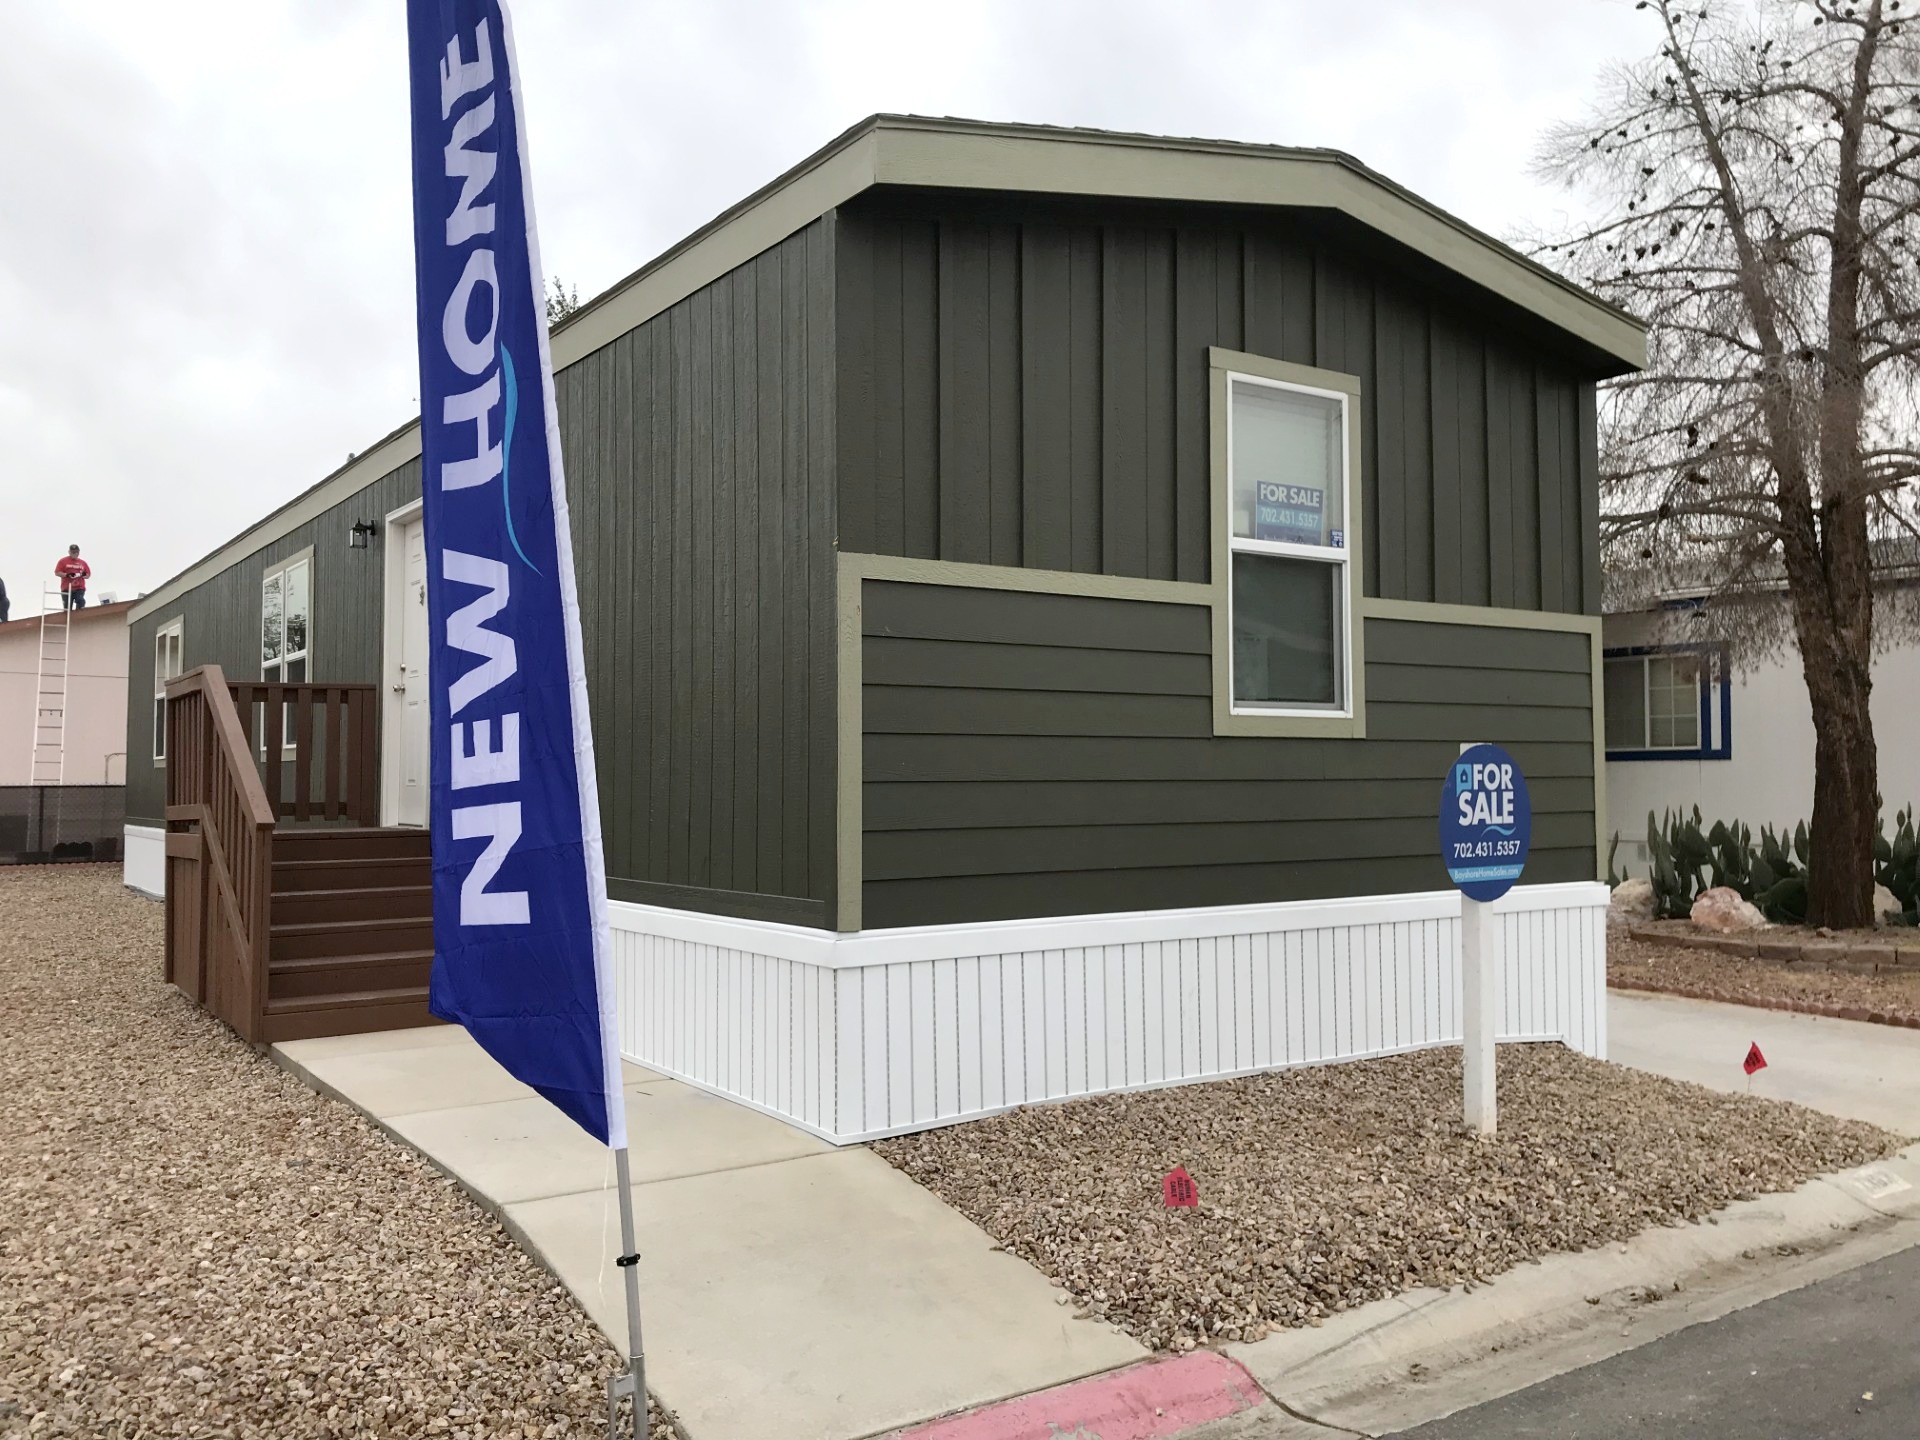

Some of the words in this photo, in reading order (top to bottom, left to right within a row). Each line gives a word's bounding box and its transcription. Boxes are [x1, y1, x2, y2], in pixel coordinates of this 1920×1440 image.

[440, 16, 504, 491] HOME
[1260, 484, 1288, 503] FOR
[1290, 488, 1320, 507] SALE
[1260, 507, 1319, 528] 702.431.5357
[442, 548, 531, 926] NEW
[1472, 763, 1514, 791] FOR
[1458, 791, 1514, 826] SALE
[1454, 840, 1521, 858] 702.431.5357
